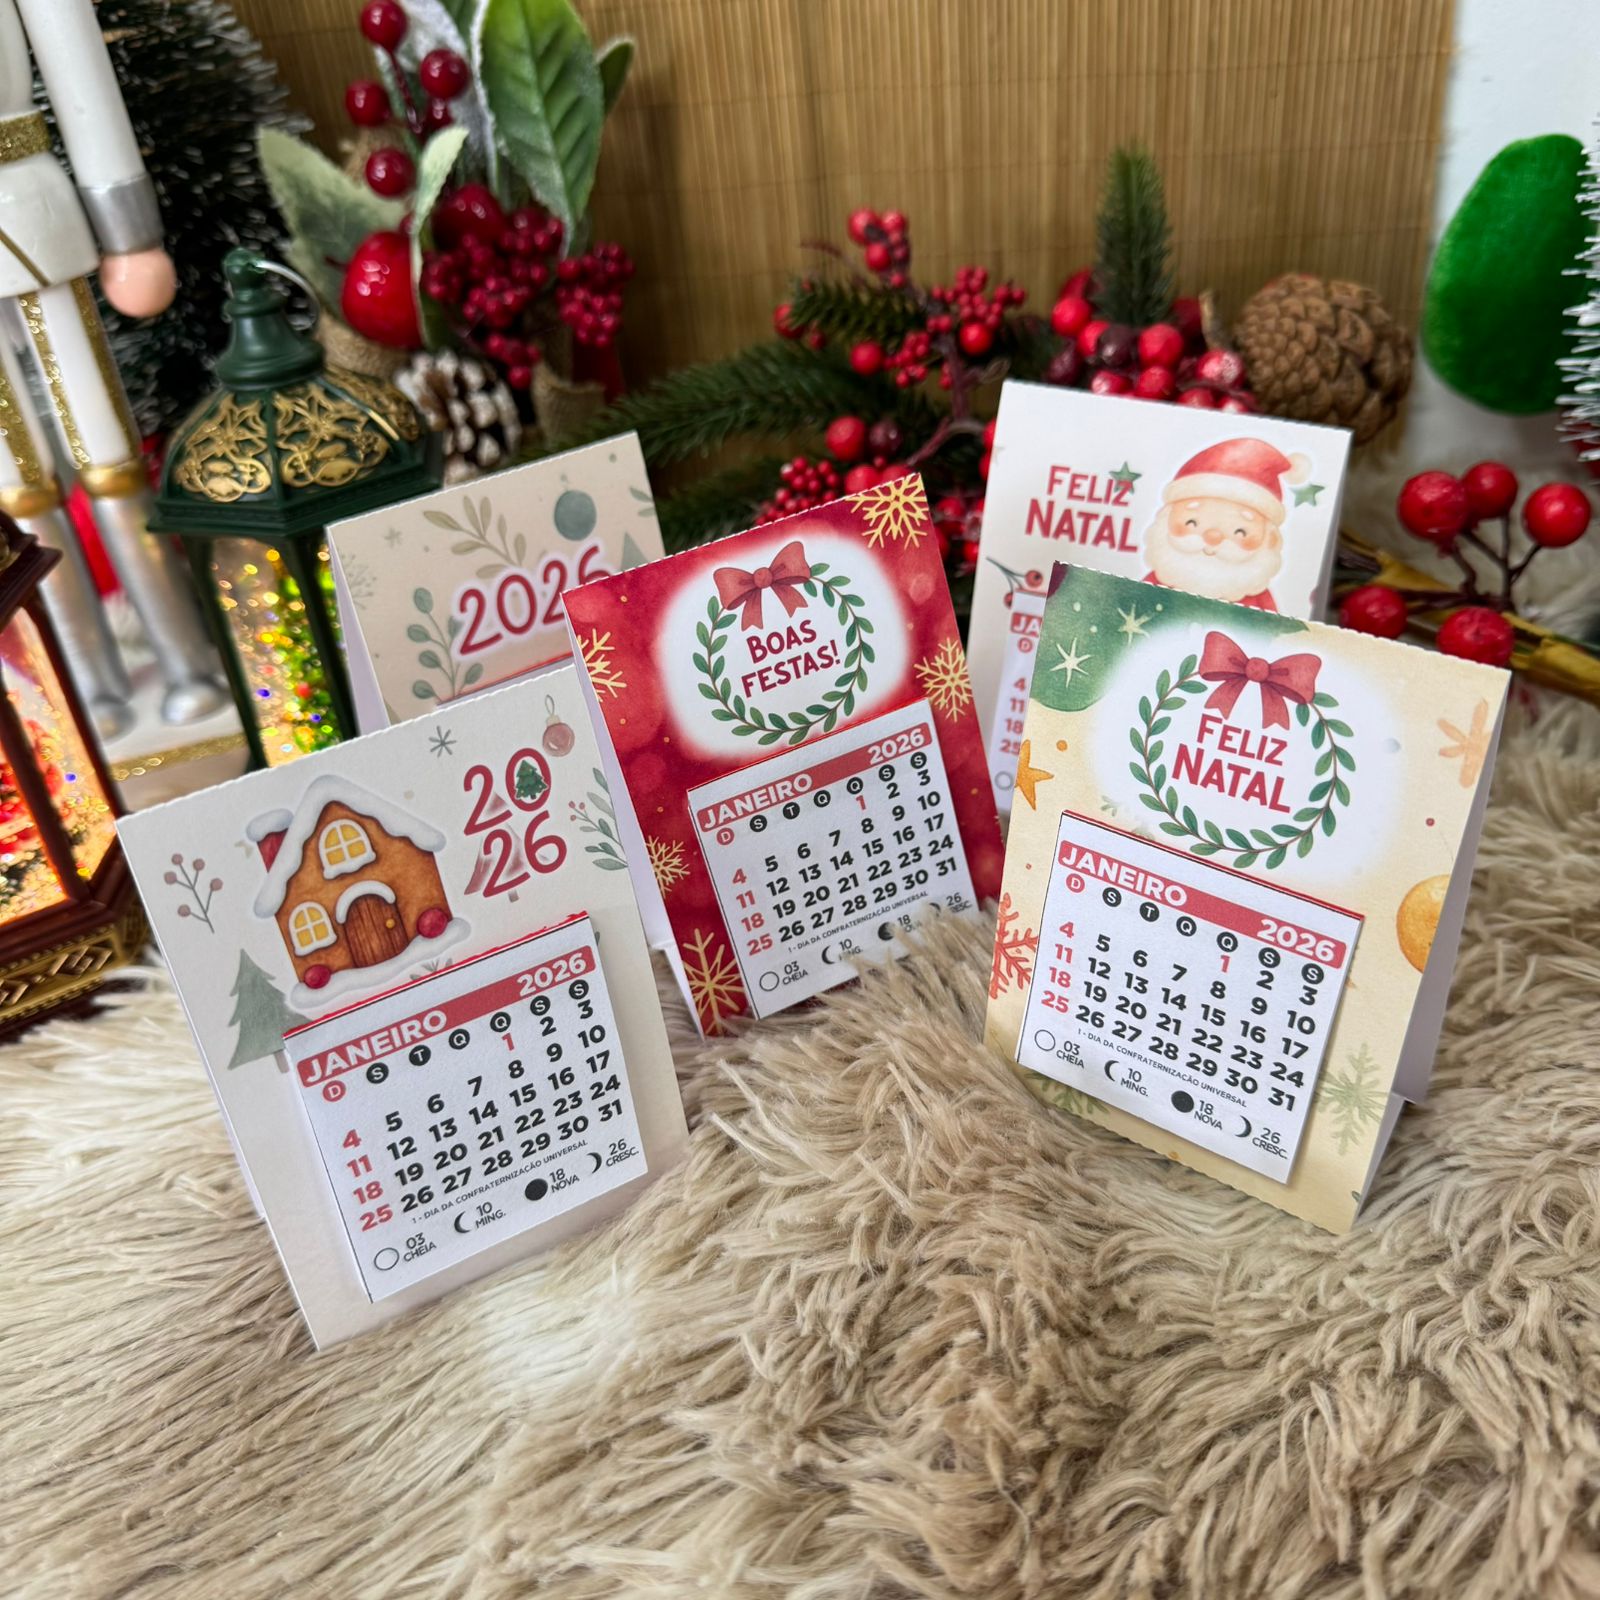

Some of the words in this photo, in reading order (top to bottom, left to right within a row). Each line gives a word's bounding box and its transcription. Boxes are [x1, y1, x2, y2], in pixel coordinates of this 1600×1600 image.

[1047, 465, 1132, 507] FELIZ
[1025, 498, 1138, 553] NATAL
[747, 619, 817, 664] BOAS
[741, 639, 841, 698] FESTAS!
[1013, 677, 1027, 692] 4
[1004, 718, 1024, 735] 18
[1010, 697, 1025, 714] 11
[1196, 714, 1287, 767] FELIZ
[463, 748, 551, 835] 20
[704, 774, 812, 828] JANEIRO
[868, 728, 924, 765] 2026
[856, 795, 866, 810] 1
[886, 782, 900, 800] 2
[917, 769, 931, 786] 3
[1172, 743, 1291, 814] NATAL
[482, 810, 567, 898] 26
[732, 868, 747, 884] 4
[764, 855, 778, 872] 5
[797, 842, 811, 859] 6
[828, 829, 841, 847] 7
[861, 818, 874, 834] 8
[892, 805, 905, 822] 9
[917, 791, 940, 810] 10
[736, 890, 756, 909] 11
[766, 877, 790, 896] 12
[798, 863, 822, 883] 13
[830, 850, 854, 871] 14
[862, 838, 884, 858] 15
[892, 825, 915, 845] 16
[924, 812, 944, 832] 17
[741, 912, 764, 932] 18
[772, 899, 796, 919] 19
[803, 886, 830, 908] 20
[837, 872, 859, 894] 21
[866, 860, 892, 882] 22
[898, 846, 922, 869] 23
[928, 834, 954, 856] 24
[747, 933, 773, 956] 25
[778, 920, 805, 942] 26
[810, 906, 834, 929] 27
[842, 894, 867, 916] 28
[872, 882, 897, 904] 29
[902, 869, 928, 890] 30
[936, 857, 957, 876] 31
[1062, 847, 1187, 906] JANEIRO
[1257, 919, 1336, 962] 2026
[797, 940, 810, 949] DIA
[810, 935, 821, 944] DA
[822, 906, 891, 939] CONFRATERNIZAÇÃO
[892, 891, 928, 910] UNIVERSAL
[839, 938, 852, 951] 10
[782, 969, 808, 985] CHEIA
[784, 960, 800, 975] 03
[1059, 922, 1074, 938] 4
[1095, 934, 1111, 952] 5
[1133, 950, 1148, 968] 6
[1171, 964, 1188, 982] 7
[1210, 980, 1226, 999] 8
[1250, 997, 1268, 1015] 9
[1287, 1010, 1316, 1035] 10
[1220, 954, 1230, 973] 1
[1256, 970, 1274, 991] 2
[1299, 985, 1318, 1006] 3
[306, 1010, 447, 1083] JANEIRO
[517, 952, 586, 997] 2026
[501, 1032, 515, 1051] 1
[540, 1016, 557, 1037] 2
[577, 999, 594, 1020] 3
[1049, 966, 1071, 988] 18
[1084, 981, 1107, 1003] 19
[1115, 995, 1147, 1020] 20
[1156, 1013, 1182, 1036] 21
[1191, 1028, 1223, 1054] 22
[1230, 1045, 1264, 1070] 23
[1270, 1062, 1304, 1088] 24
[1055, 943, 1073, 964] 11
[1088, 957, 1111, 980] 12
[1124, 972, 1149, 994] 13
[1161, 987, 1187, 1011] 14
[1201, 1004, 1226, 1026] 15
[1240, 1020, 1266, 1044] 16
[1282, 1037, 1309, 1059] 17
[1041, 990, 1069, 1013] 25
[1075, 1005, 1105, 1028] 26
[1112, 1020, 1142, 1042] 27
[1148, 1036, 1179, 1060] 28
[1186, 1052, 1218, 1077] 29
[1224, 1068, 1258, 1094] 30
[1268, 1086, 1296, 1112] 31
[1056, 1050, 1084, 1069] CHEIA
[1064, 1040, 1080, 1056] 03
[1087, 1032, 1101, 1044] DIA
[1103, 1039, 1114, 1049] DA
[1116, 1045, 1199, 1086] CONFRATERNIZAÇÃO
[1200, 1082, 1247, 1108] UNIVERSAL
[342, 1129, 362, 1148] 4
[385, 1111, 403, 1132] 5
[427, 1094, 444, 1114] 6
[467, 1076, 482, 1097] 7
[508, 1060, 524, 1079] 8
[546, 1043, 563, 1062] 9
[577, 1024, 606, 1048] 10
[1120, 1078, 1149, 1096] MING.
[1128, 1068, 1142, 1083] 10
[346, 1154, 372, 1178] 11
[386, 1136, 417, 1160] 12
[428, 1117, 458, 1143] 13
[468, 1100, 499, 1125] 14
[509, 1083, 536, 1107] 15
[547, 1066, 575, 1090] 16
[586, 1050, 610, 1074] 17
[1194, 1110, 1223, 1130] NOVA
[1200, 1100, 1214, 1116] 18
[353, 1181, 383, 1204] 18
[394, 1162, 424, 1186] 19
[433, 1143, 468, 1171] 20
[477, 1125, 504, 1151] 21
[514, 1108, 546, 1134] 22
[552, 1090, 583, 1117] 23
[589, 1074, 621, 1101] 24
[606, 1146, 640, 1167] CRESC.
[608, 1138, 627, 1156] 26
[1252, 1137, 1288, 1160] CRESC.
[1260, 1127, 1281, 1144] 26
[360, 1204, 393, 1232] 25
[400, 1185, 434, 1213] 26
[442, 1166, 472, 1194] 27
[482, 1150, 513, 1176] 28
[520, 1132, 551, 1159] 29
[557, 1116, 589, 1140] 30
[598, 1098, 622, 1122] 31
[424, 1208, 440, 1219] DIA
[441, 1201, 454, 1211] DA
[455, 1160, 542, 1204] CONFRATERNIZAÇÃO
[543, 1140, 588, 1164] UNIVERSAL
[549, 1168, 566, 1183] 18
[551, 1174, 580, 1193] NOVA
[475, 1209, 506, 1229] MING.
[476, 1202, 493, 1216] 10
[403, 1241, 437, 1262] CHEIA
[406, 1232, 426, 1250] 03
